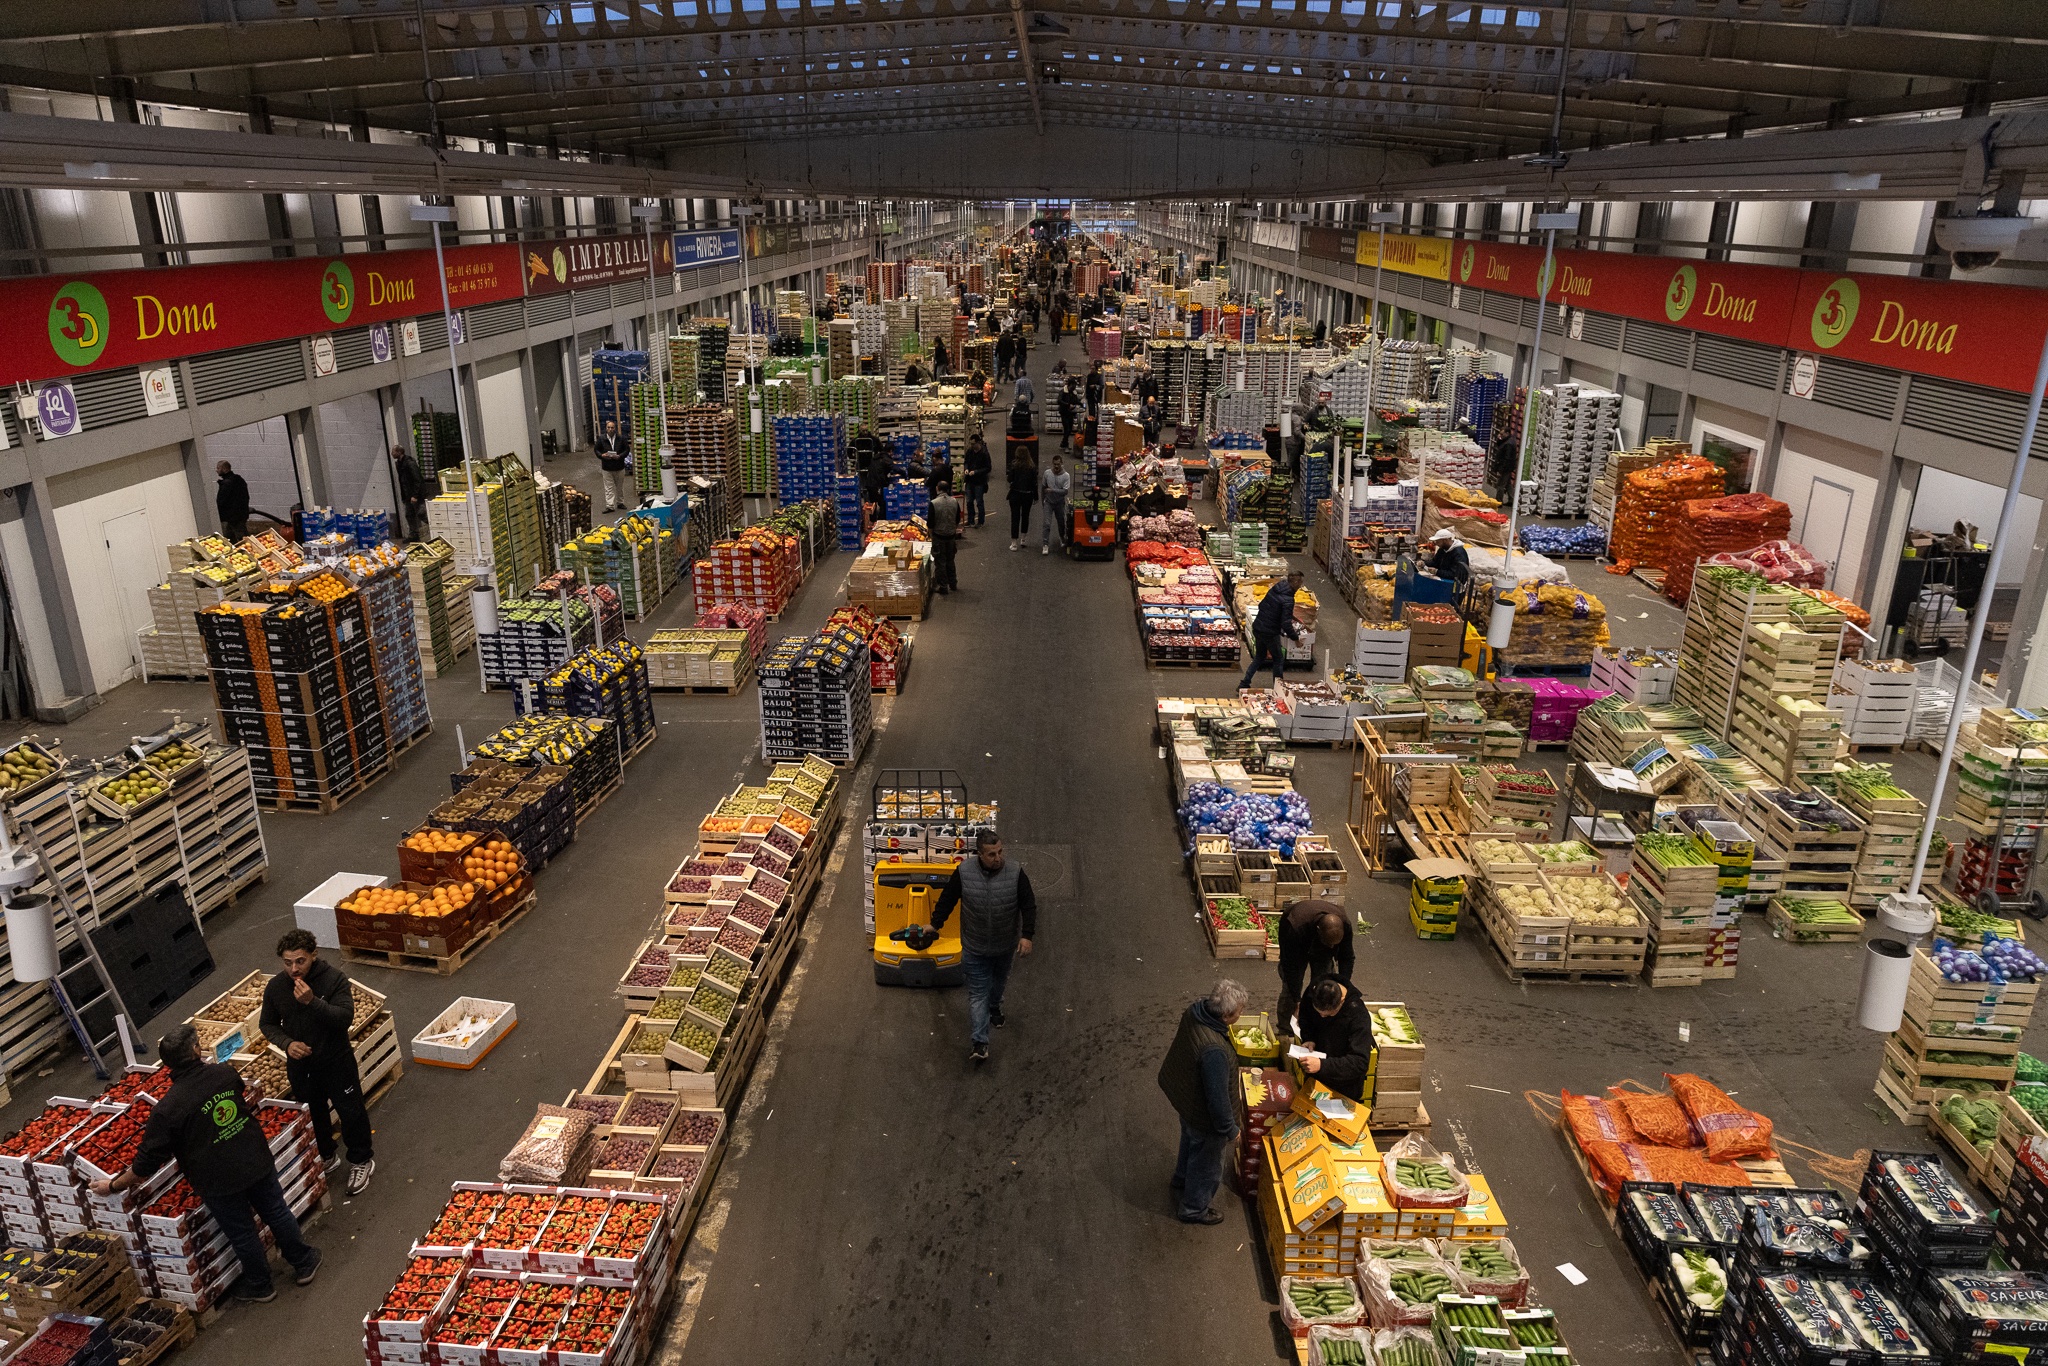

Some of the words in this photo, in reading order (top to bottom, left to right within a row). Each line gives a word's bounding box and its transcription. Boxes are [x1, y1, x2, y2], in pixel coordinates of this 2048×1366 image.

[570, 240, 648, 271] IMPERIAL
[696, 236, 723, 258] RIVIERA
[1486, 256, 1510, 281] Dona
[1560, 266, 1592, 296] Dona
[367, 272, 415, 307] Dona
[1703, 283, 1757, 323] Dona
[133, 295, 218, 341] Dona
[1870, 300, 1959, 354] Dona
[45, 388, 70, 420] fel
[201, 1100, 212, 1114] 3D
[213, 1090, 234, 1103] Dona
[1912, 1174, 1946, 1211] SAVEUR
[1650, 1201, 1673, 1230] SAVEUR
[1711, 1200, 1733, 1230] SAVEUR
[1876, 1199, 1908, 1235] SAVEUR
[1990, 1290, 2047, 1301] SAVEUR
[1858, 1301, 1893, 1340] SAVEUR
[2002, 1321, 2048, 1331] SAVEU
